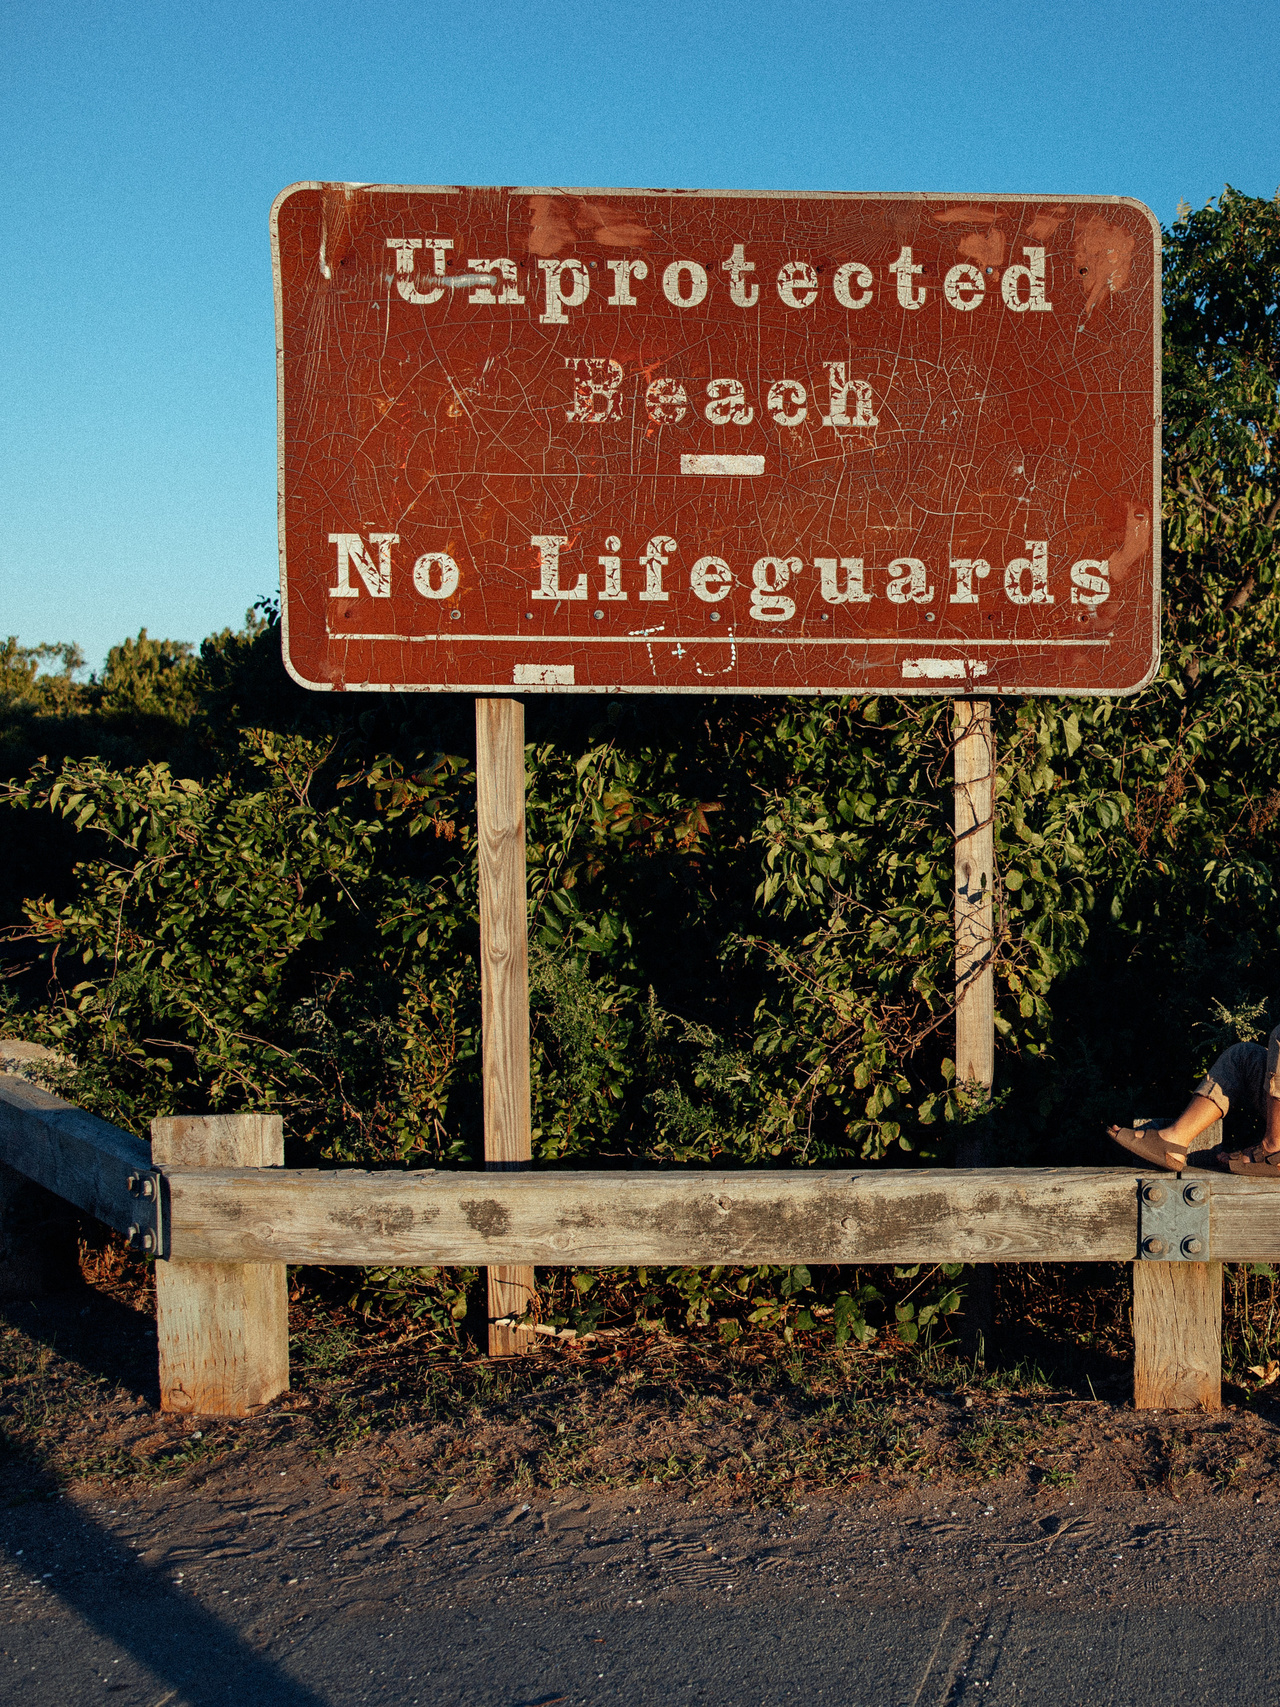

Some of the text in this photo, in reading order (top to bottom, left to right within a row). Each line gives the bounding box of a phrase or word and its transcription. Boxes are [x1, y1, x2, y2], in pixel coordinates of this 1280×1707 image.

[386, 238, 1053, 325] Unprotected
[565, 358, 879, 427] Beach
[328, 532, 1111, 622] No Lifeguards
